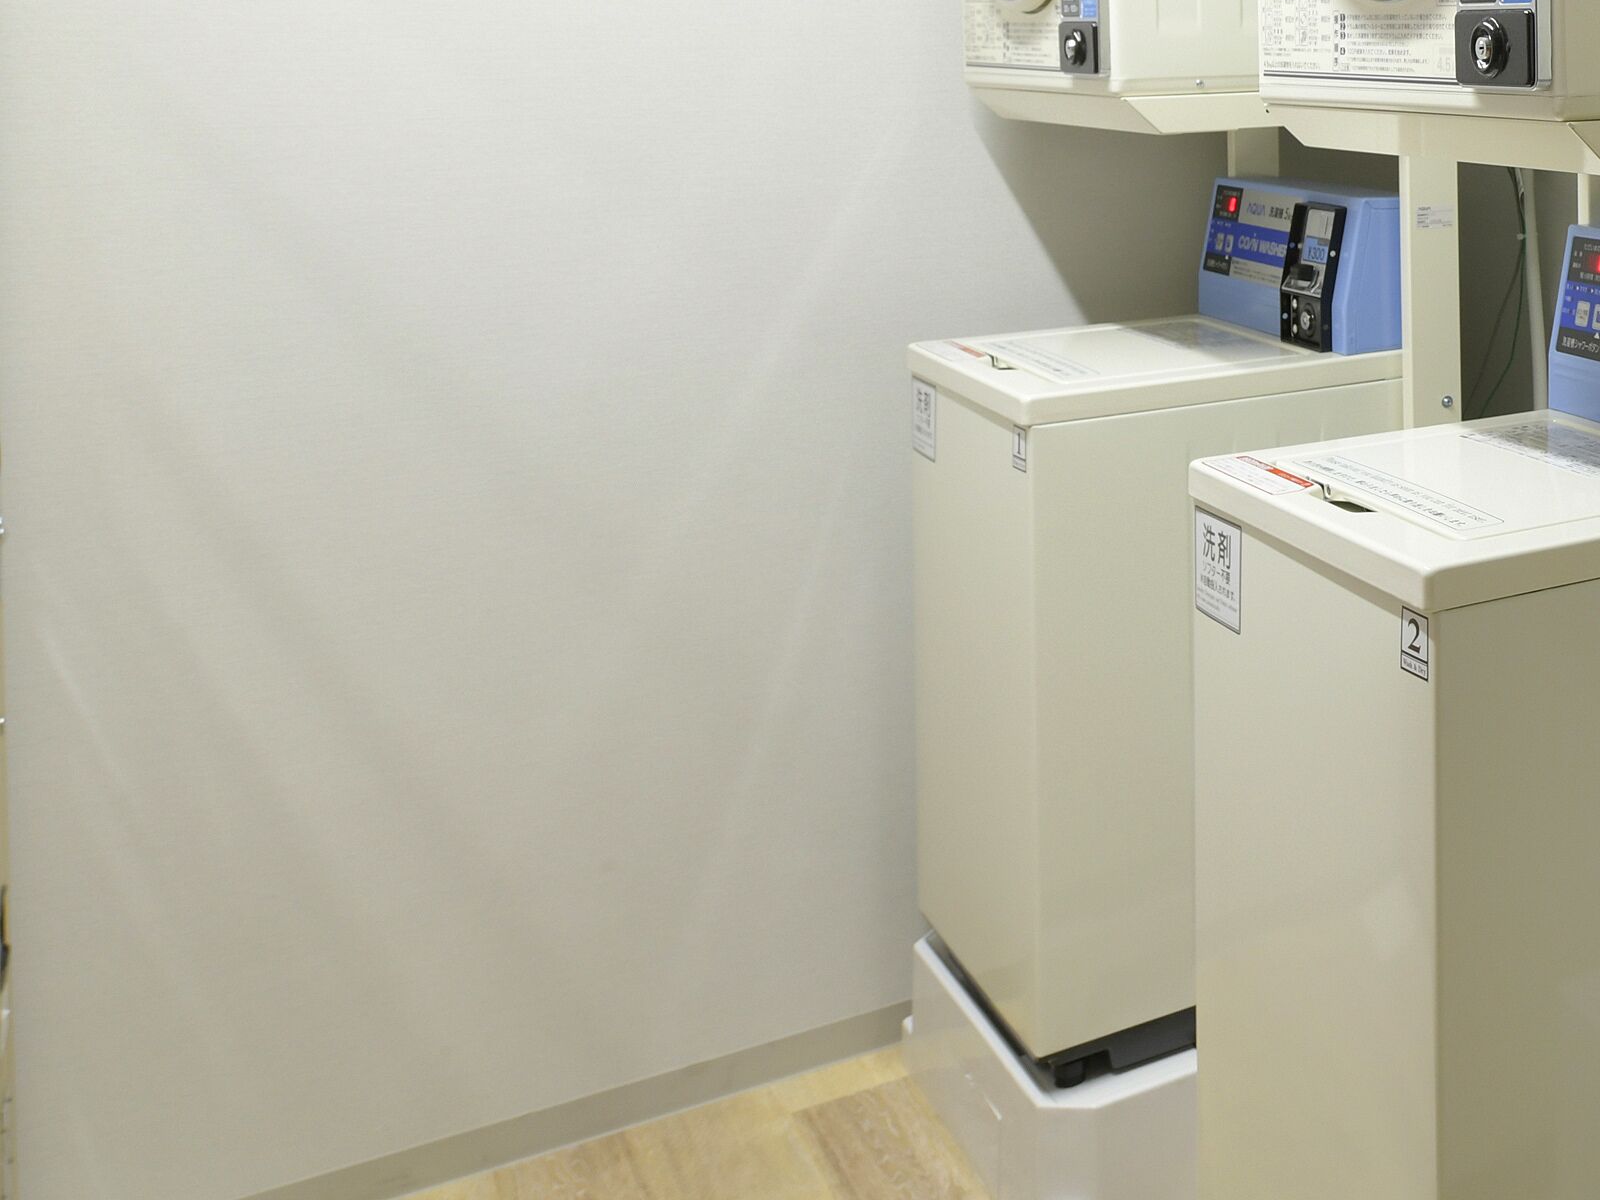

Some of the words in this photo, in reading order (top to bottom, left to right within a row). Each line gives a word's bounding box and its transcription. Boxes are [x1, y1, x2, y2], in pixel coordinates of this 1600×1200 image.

[1258, 238, 1287, 258] WASHE
[1014, 431, 1022, 456] 1
[1202, 521, 1232, 571] 洗剤
[1407, 617, 1422, 654] 2
